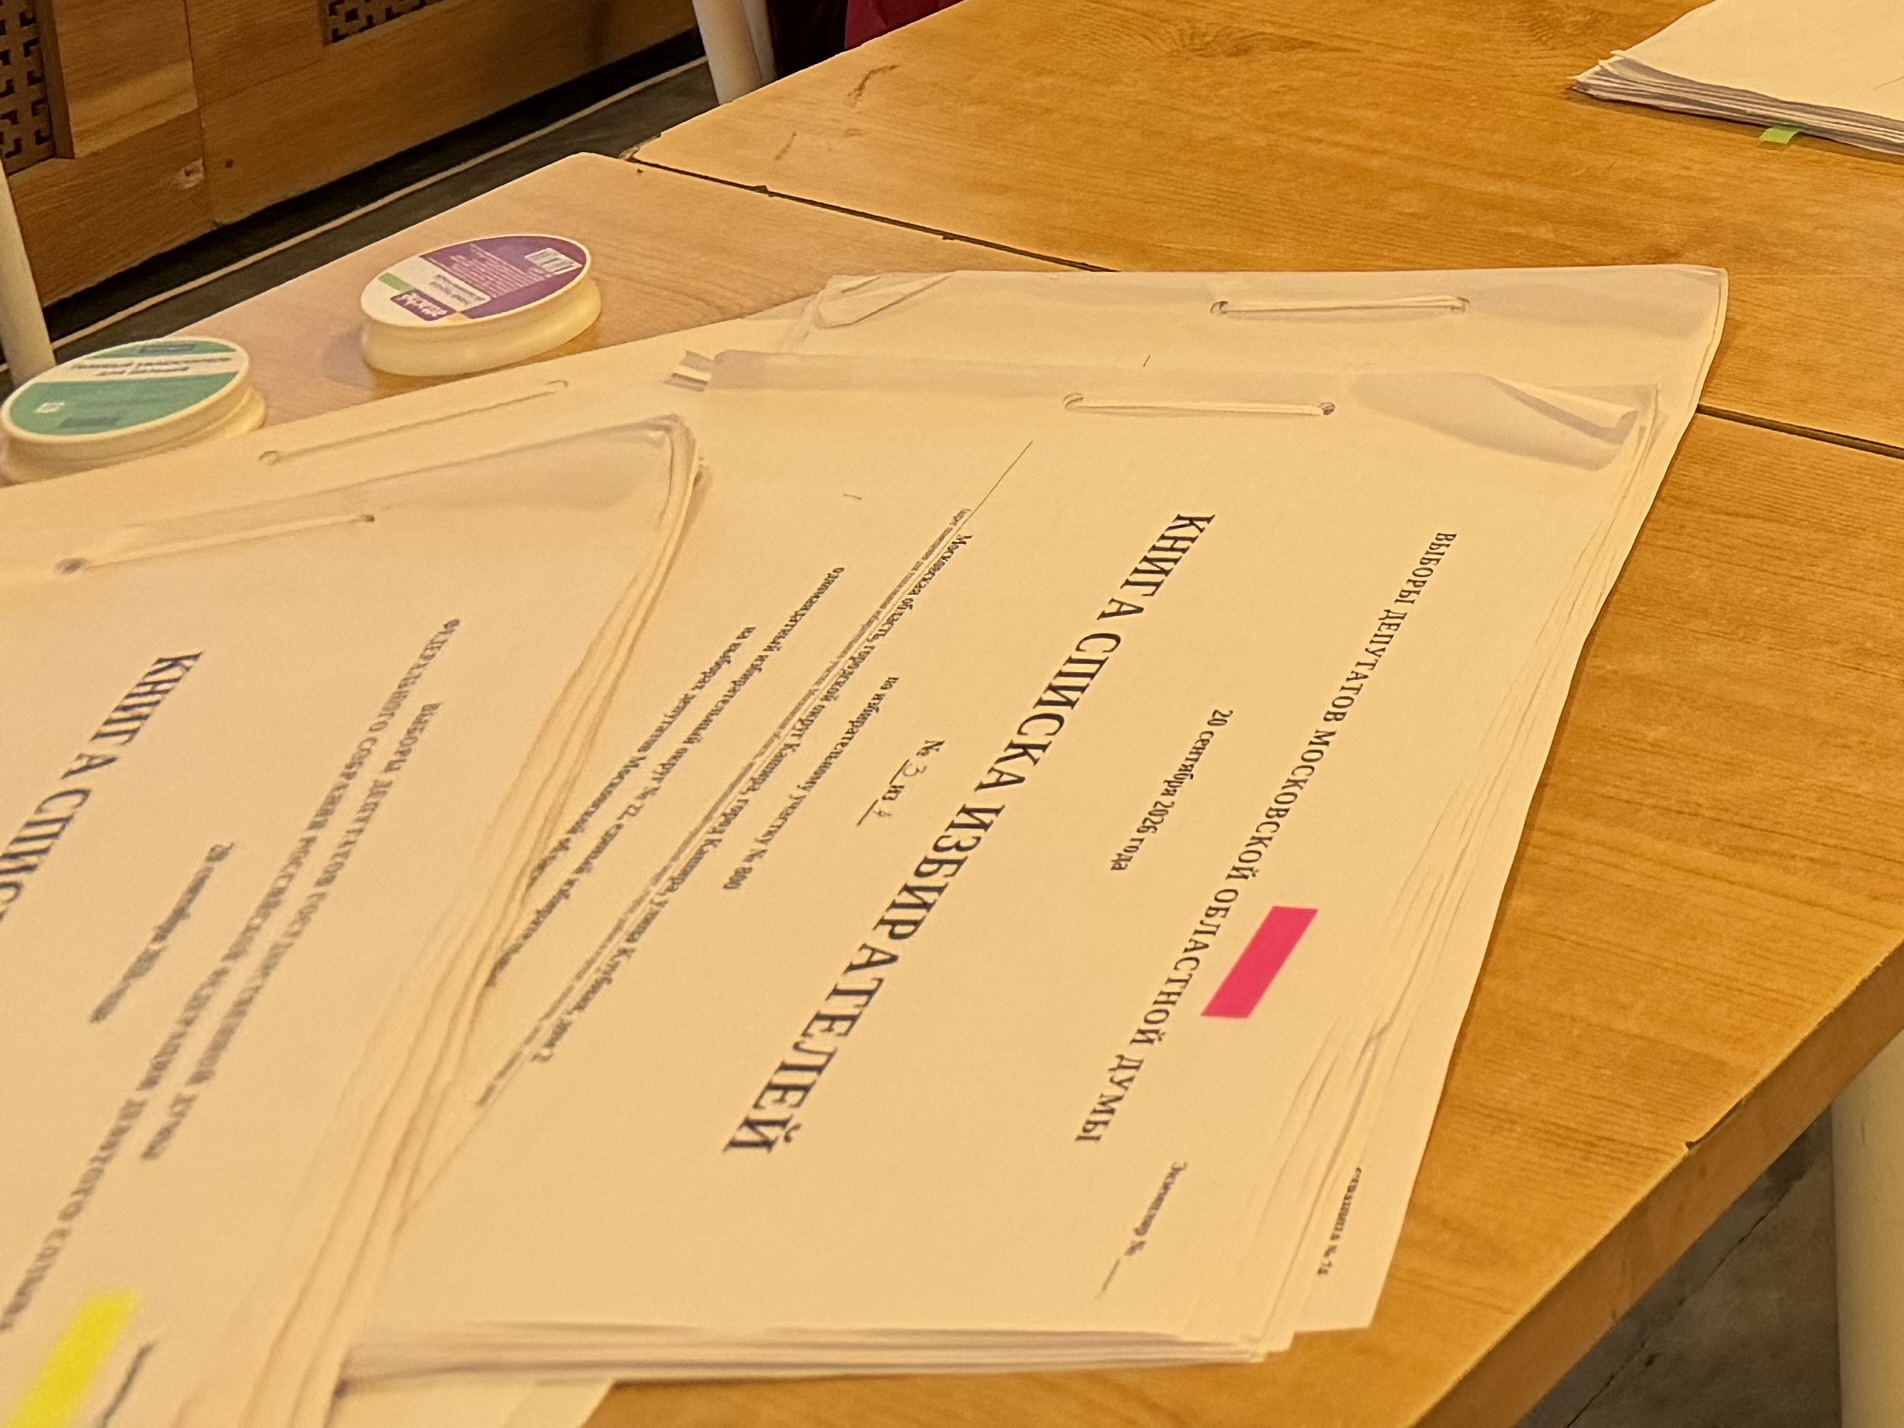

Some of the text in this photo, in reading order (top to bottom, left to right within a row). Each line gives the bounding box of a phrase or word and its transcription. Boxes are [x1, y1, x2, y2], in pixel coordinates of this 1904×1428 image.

[907, 535, 973, 596] Московская
[0, 650, 204, 923] КНИГА СПИ
[796, 693, 886, 793] избирательному
[915, 739, 946, 757] №
[1110, 709, 1234, 871] 20 сентября 2026 года
[723, 513, 1216, 1154] КНИГА СПИСКА ИЗБИРАТЕЛЕЙ
[754, 794, 807, 846] участку
[874, 784, 905, 803] из
[1074, 532, 1458, 1142] ВЫБОРЫ ДЕПУТАТОВ МОСКОВСКОЙ ОБЛАСТНОЙ ДУМЫ
